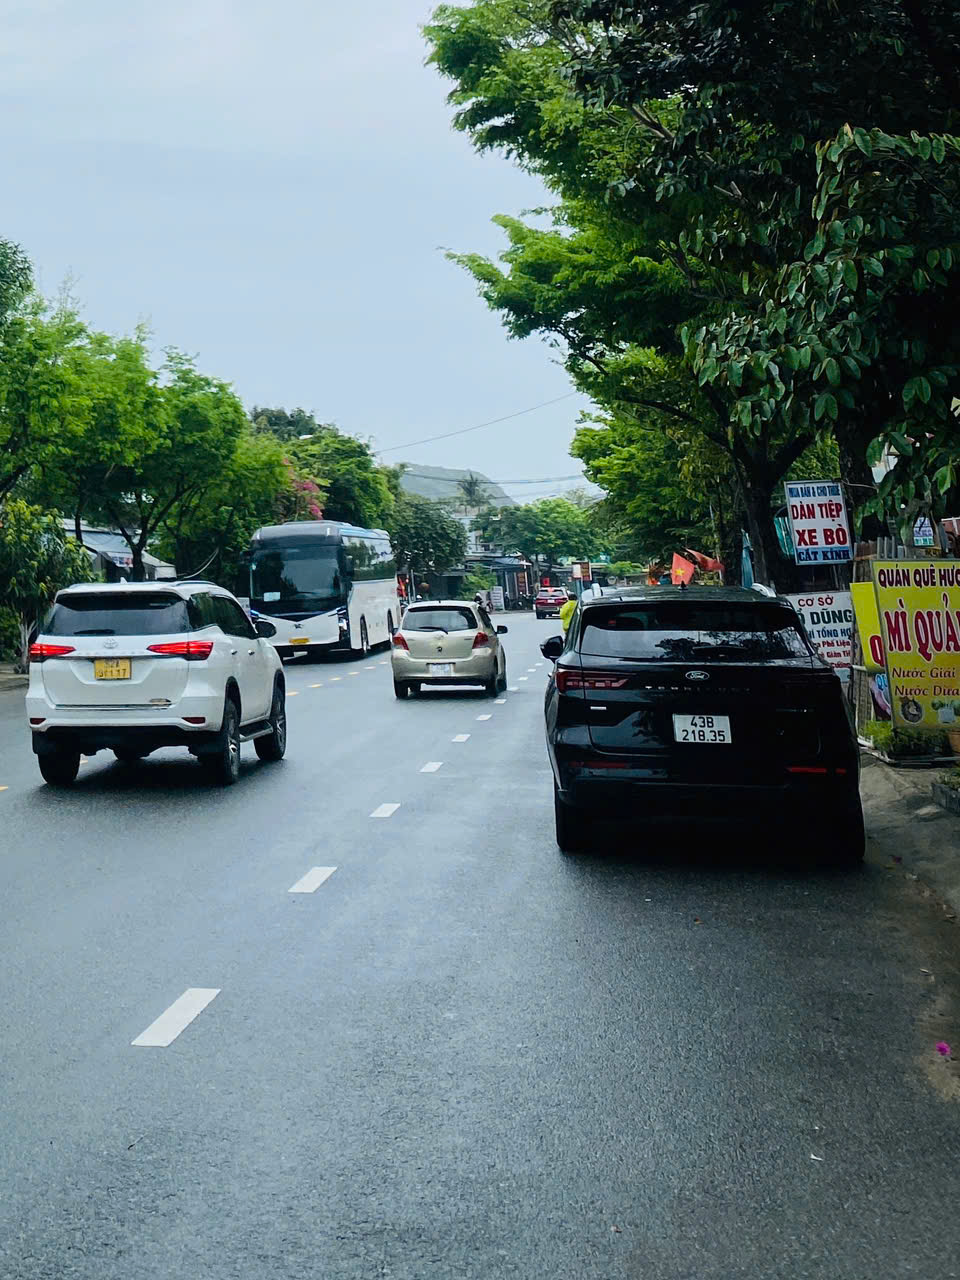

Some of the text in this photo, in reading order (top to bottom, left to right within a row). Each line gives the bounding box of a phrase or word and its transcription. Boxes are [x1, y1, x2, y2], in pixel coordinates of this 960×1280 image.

[791, 500, 843, 521] DÀN TIỆP
[796, 523, 848, 546] XE BÒ
[878, 563, 911, 588] QUÁN
[913, 563, 937, 588] QUÊ
[798, 594, 834, 607] CƠ SỞ
[810, 608, 852, 625] DŨNG
[884, 598, 912, 652] MÌ
[691, 716, 714, 728] 43B
[682, 730, 726, 742] 218.35
